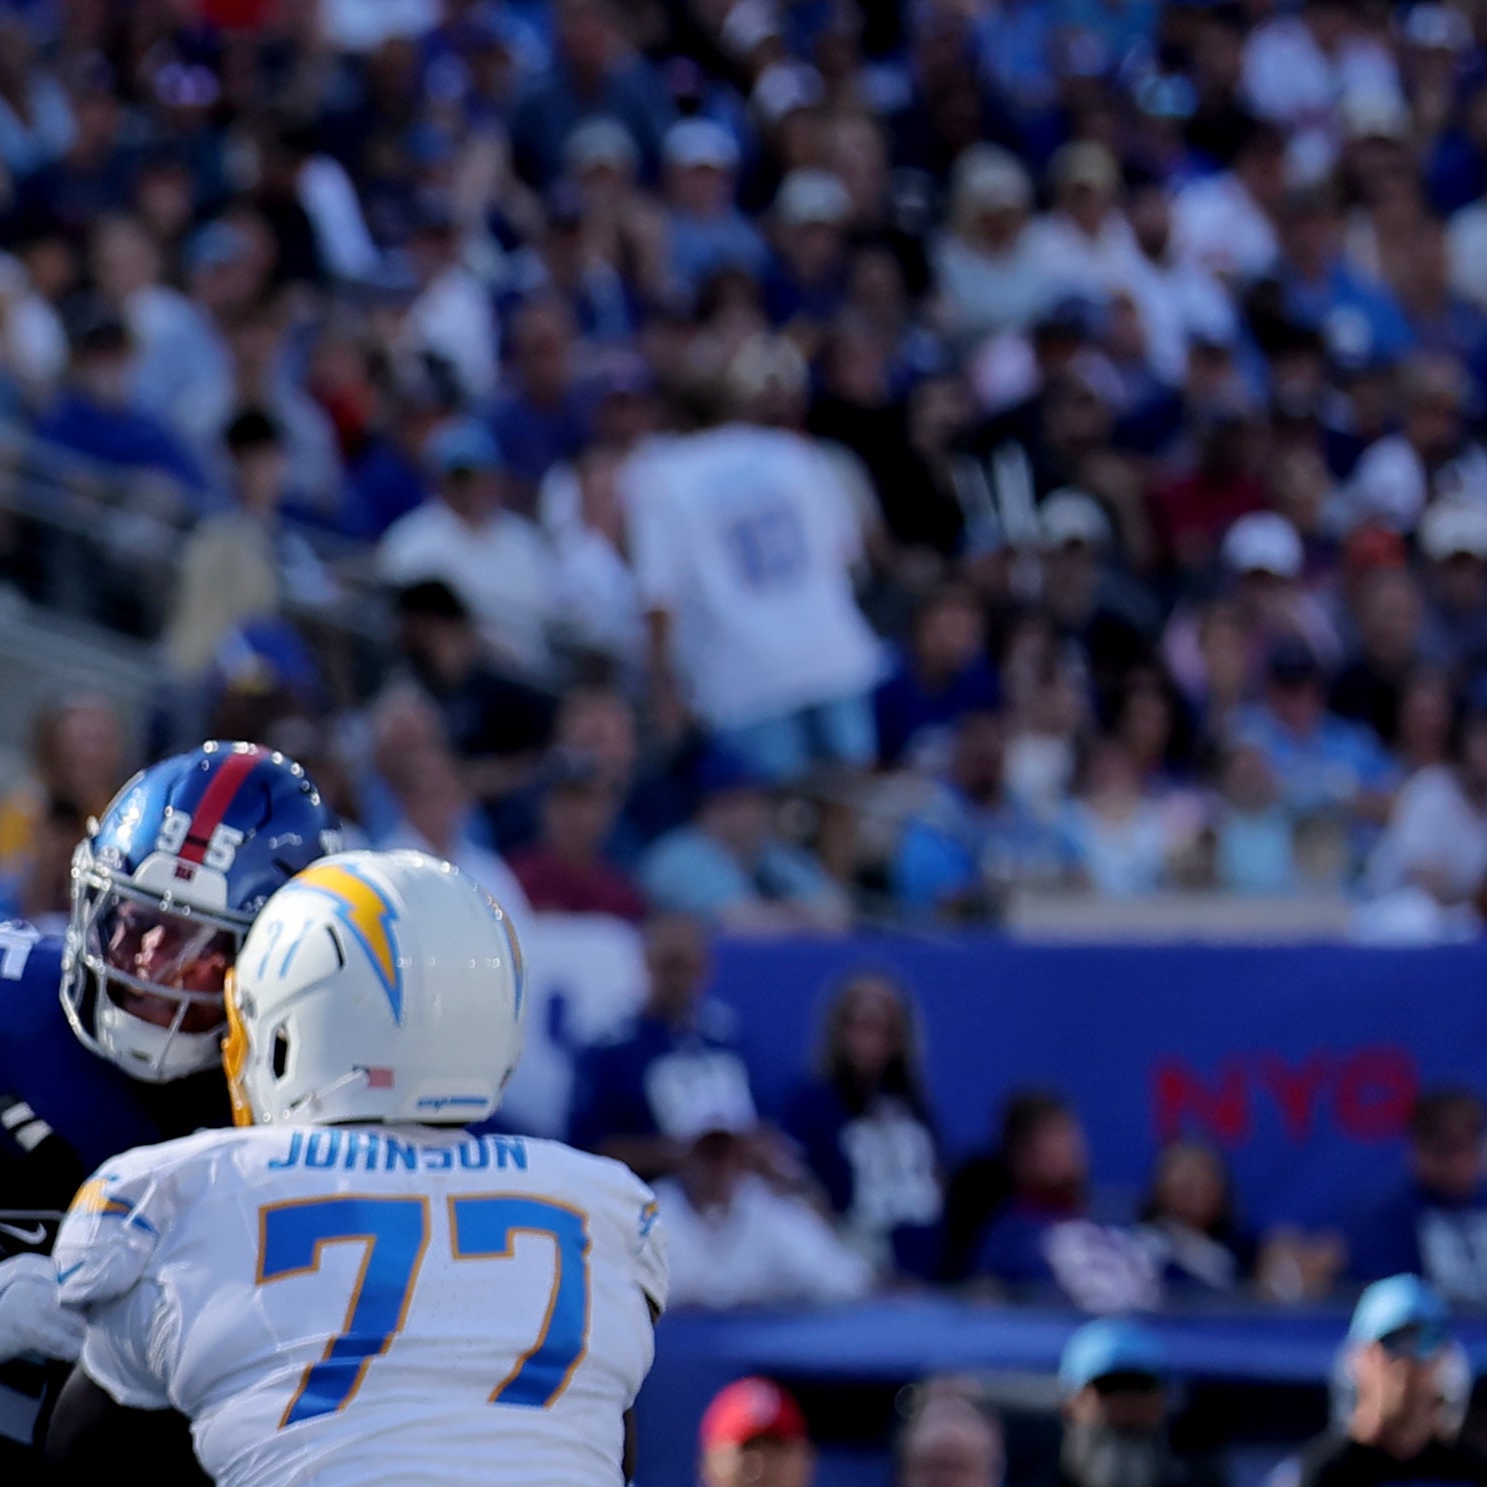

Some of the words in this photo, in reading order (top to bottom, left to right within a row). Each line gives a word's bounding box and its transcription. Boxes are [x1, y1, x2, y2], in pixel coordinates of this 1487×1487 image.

[155, 810, 245, 873] 95
[268, 1130, 528, 1170] JOHNSON
[255, 1190, 593, 1430] 77
